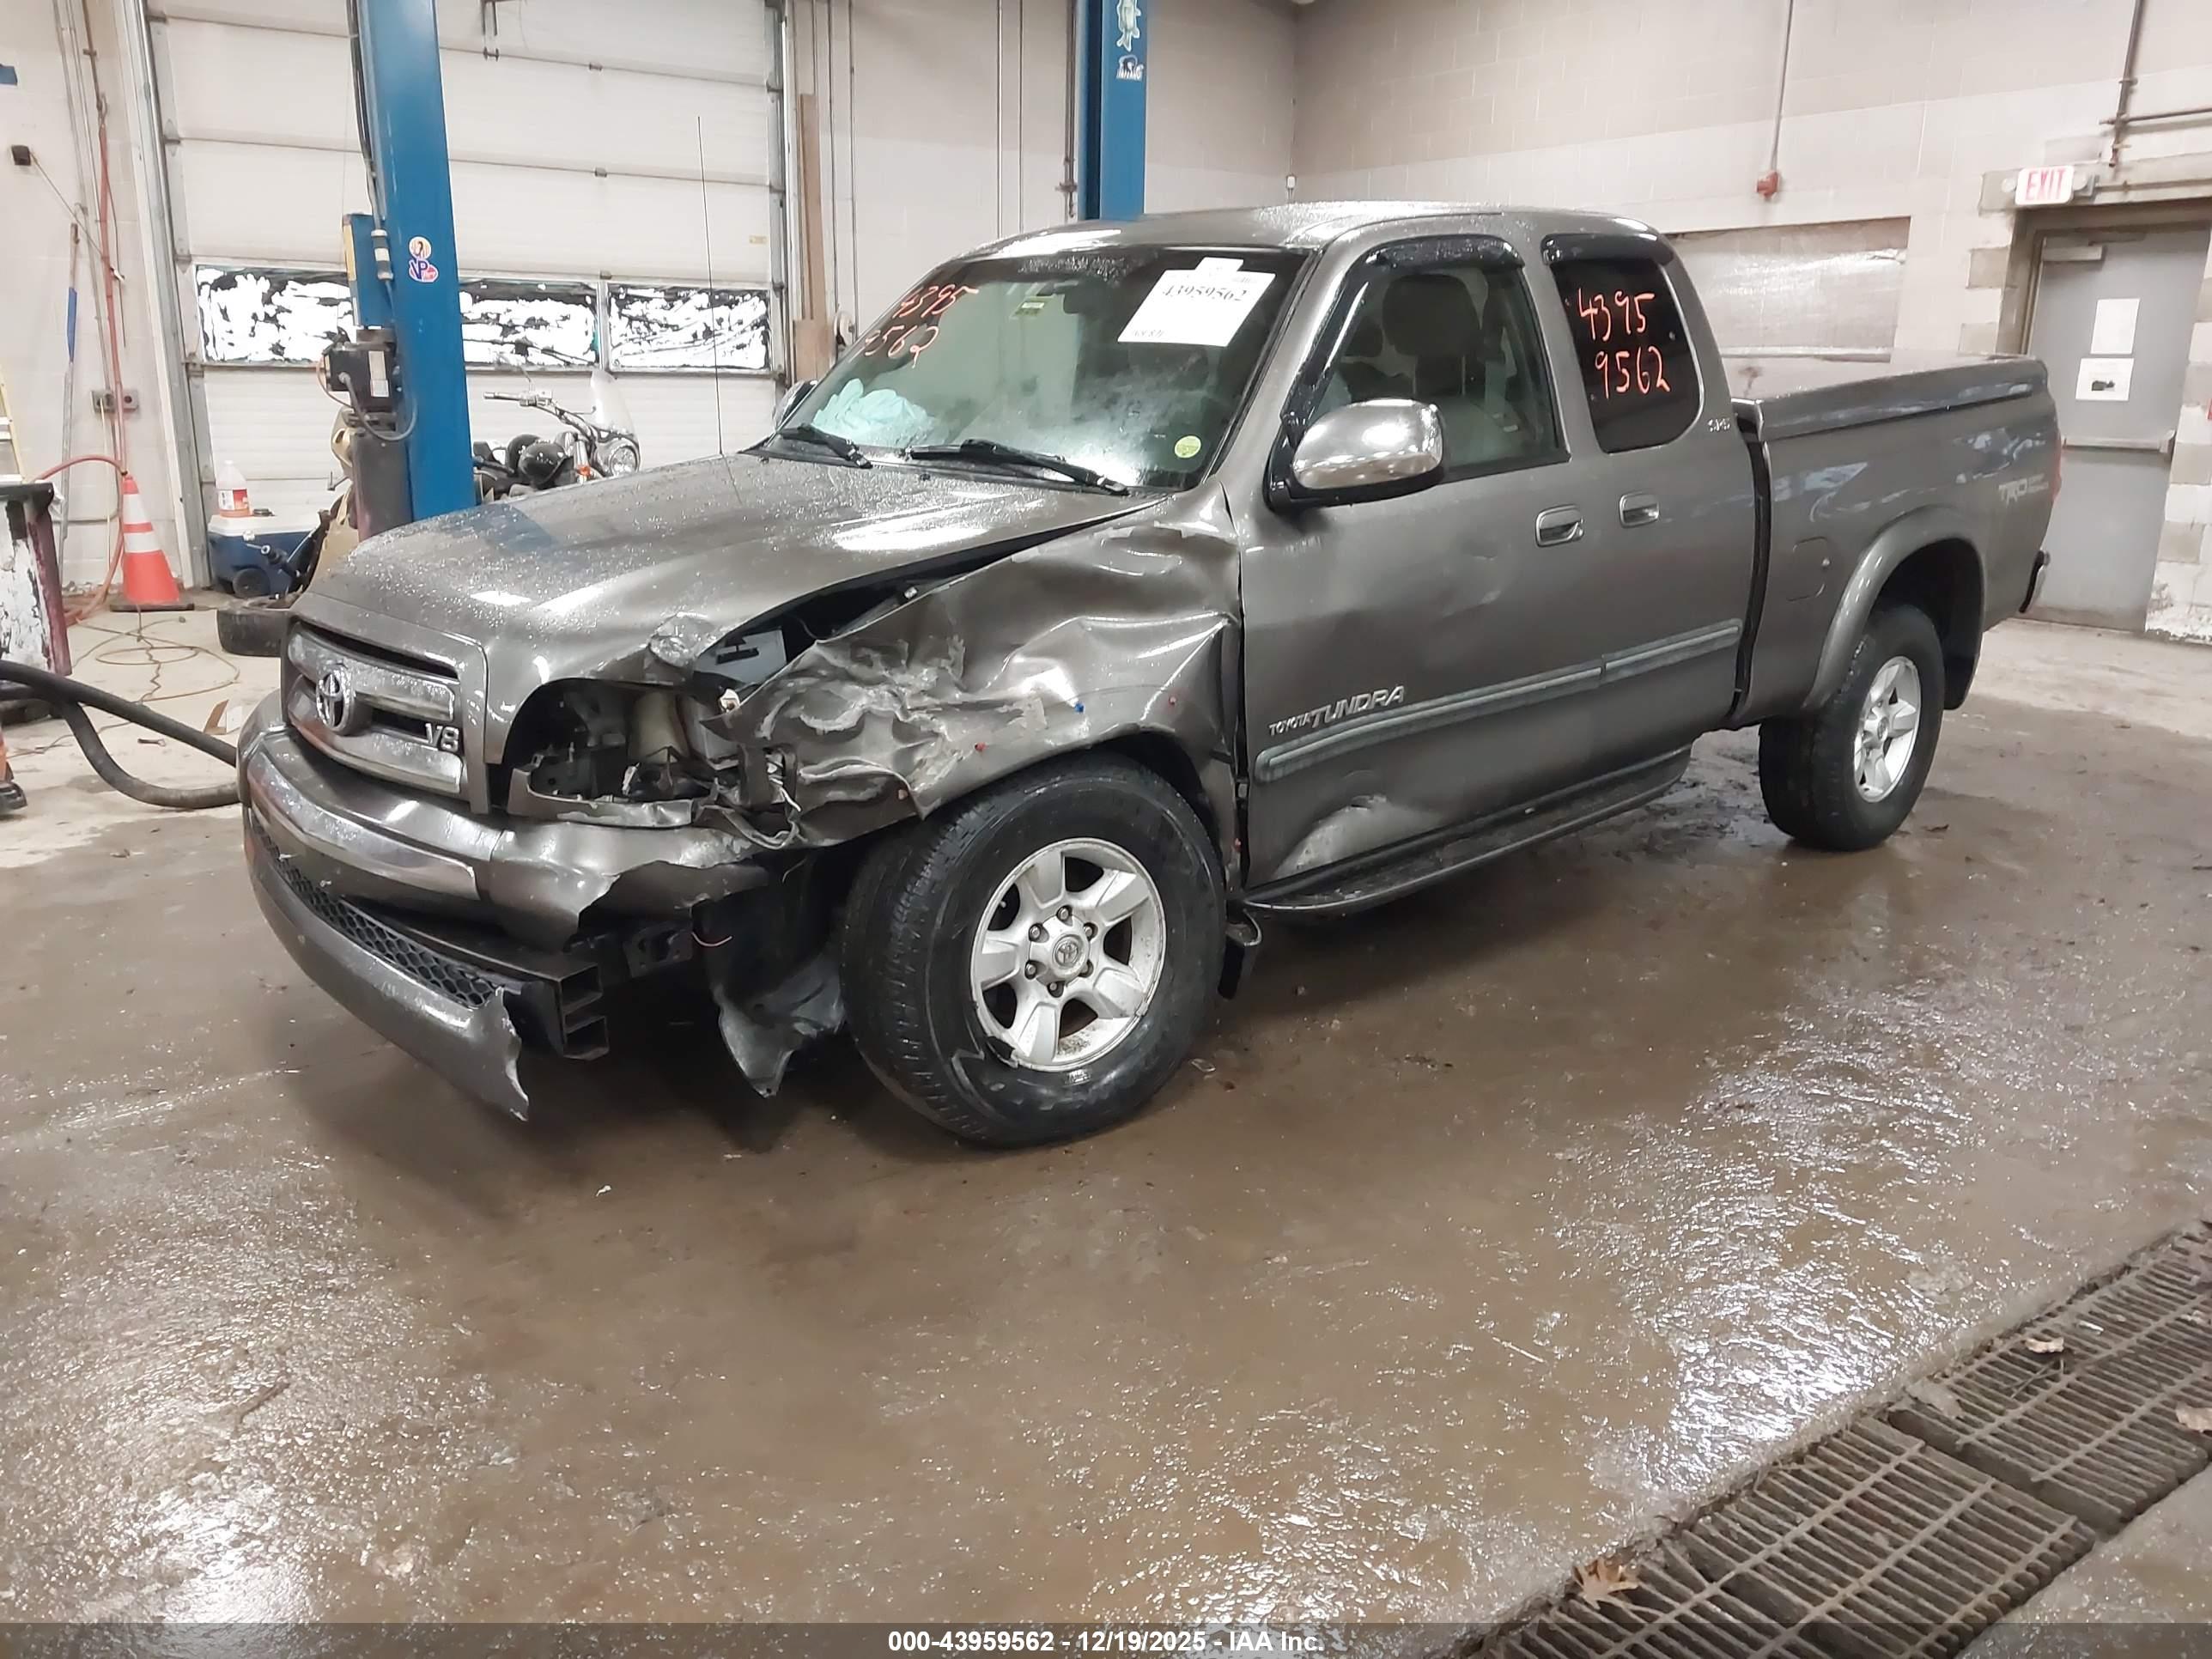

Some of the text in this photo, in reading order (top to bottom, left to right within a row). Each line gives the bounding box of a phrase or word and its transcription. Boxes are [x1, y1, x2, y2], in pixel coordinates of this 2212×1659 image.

[2024, 167, 2066, 201] EXIT
[1578, 288, 1656, 341] 4395
[1595, 345, 1671, 399] 9562
[1268, 684, 1405, 737] TOYOTA TUNDRA
[424, 722, 460, 753] V8
